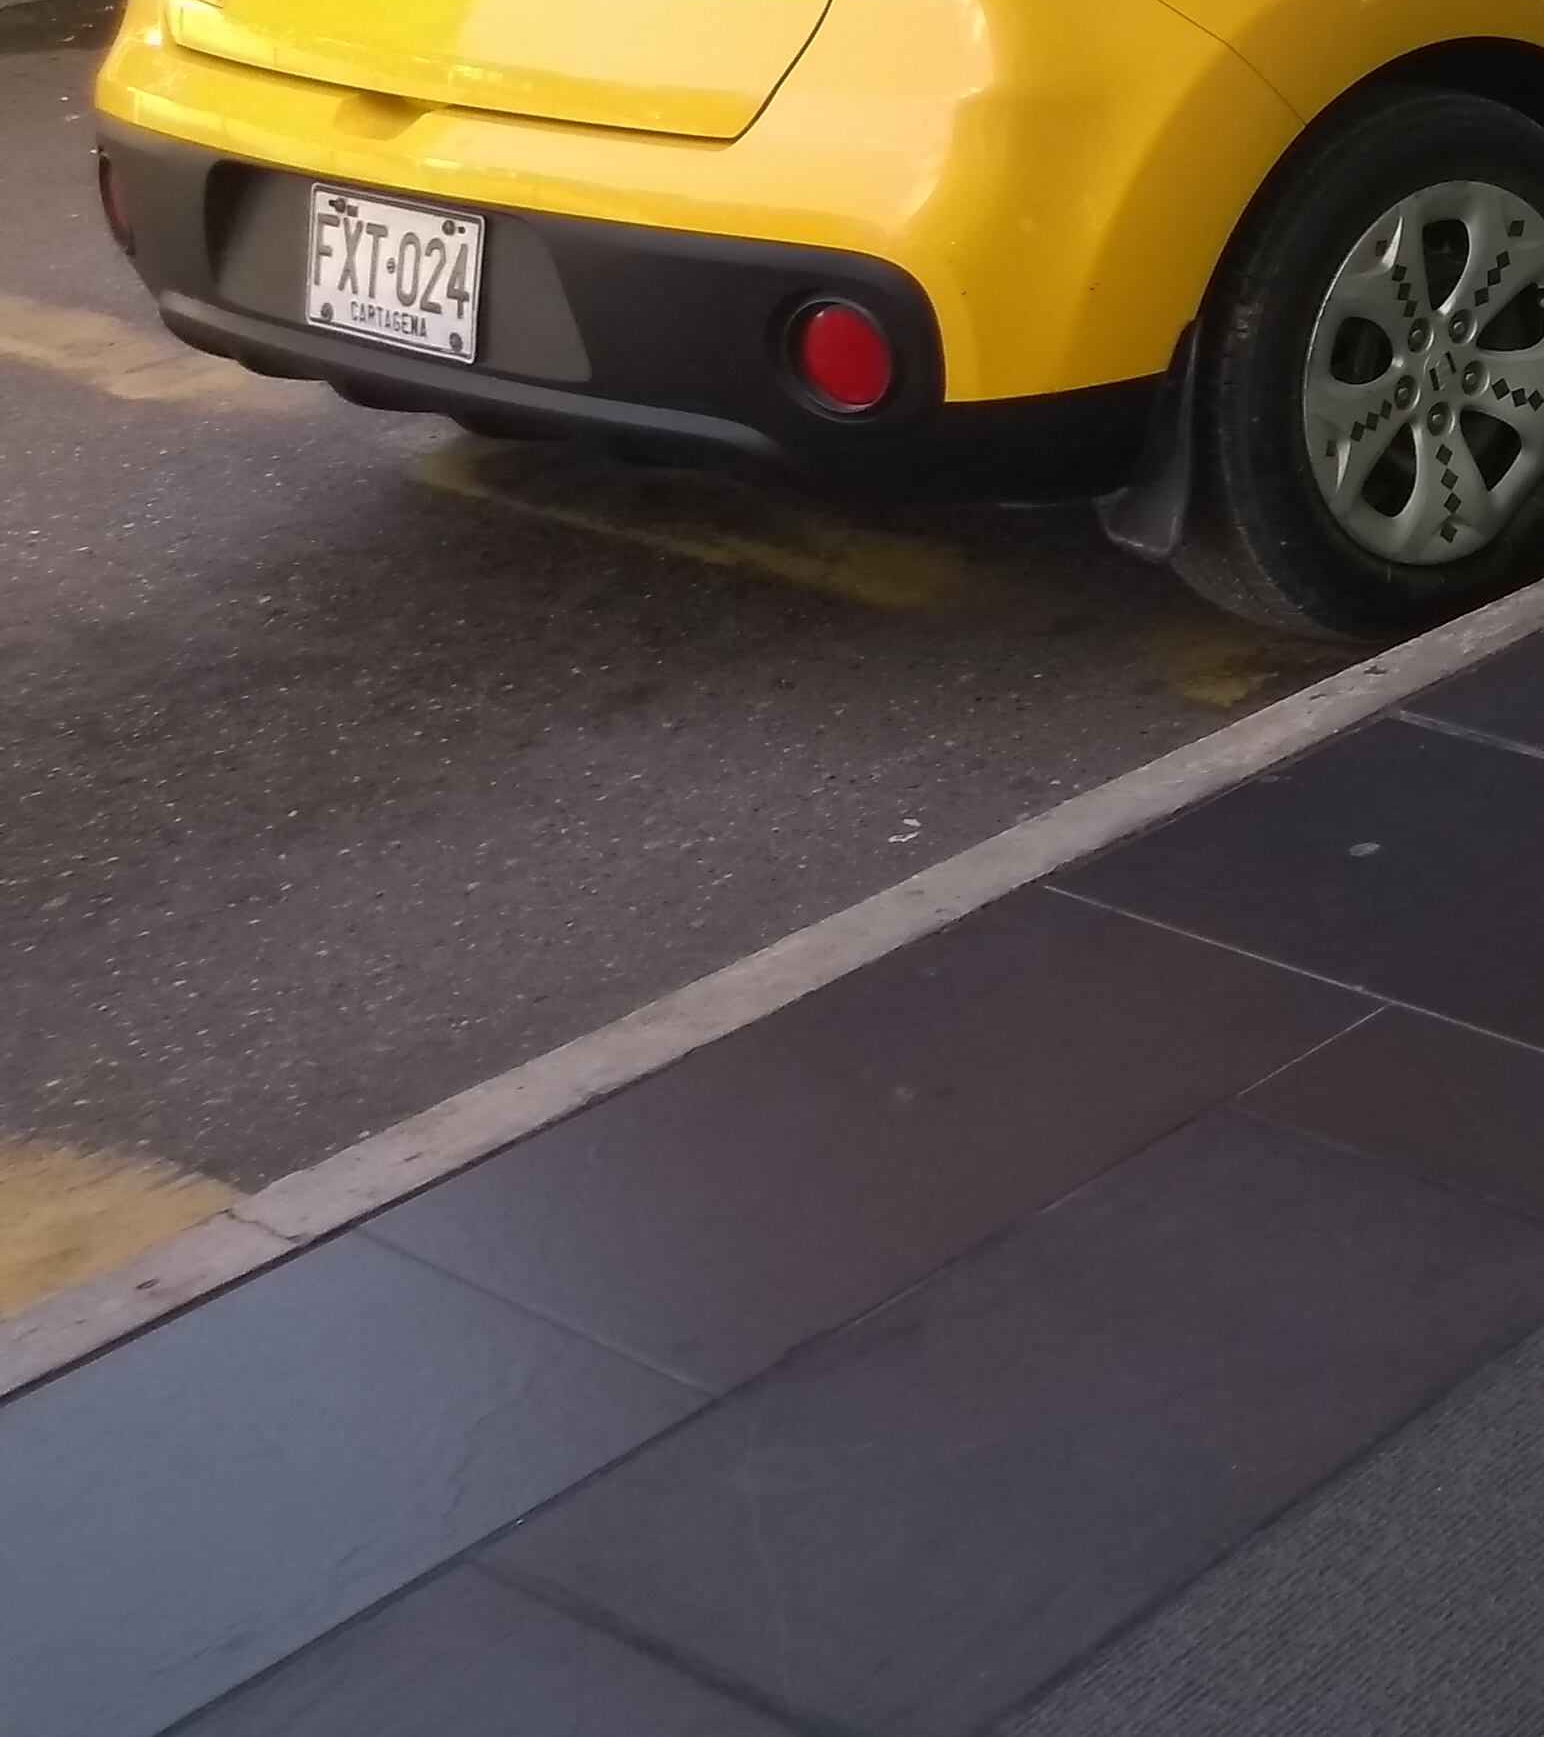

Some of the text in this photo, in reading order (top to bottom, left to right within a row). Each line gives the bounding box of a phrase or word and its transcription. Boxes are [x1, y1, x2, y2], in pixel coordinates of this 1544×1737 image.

[314, 213, 471, 320] FXT 024
[350, 300, 428, 338] CARTAGENA
